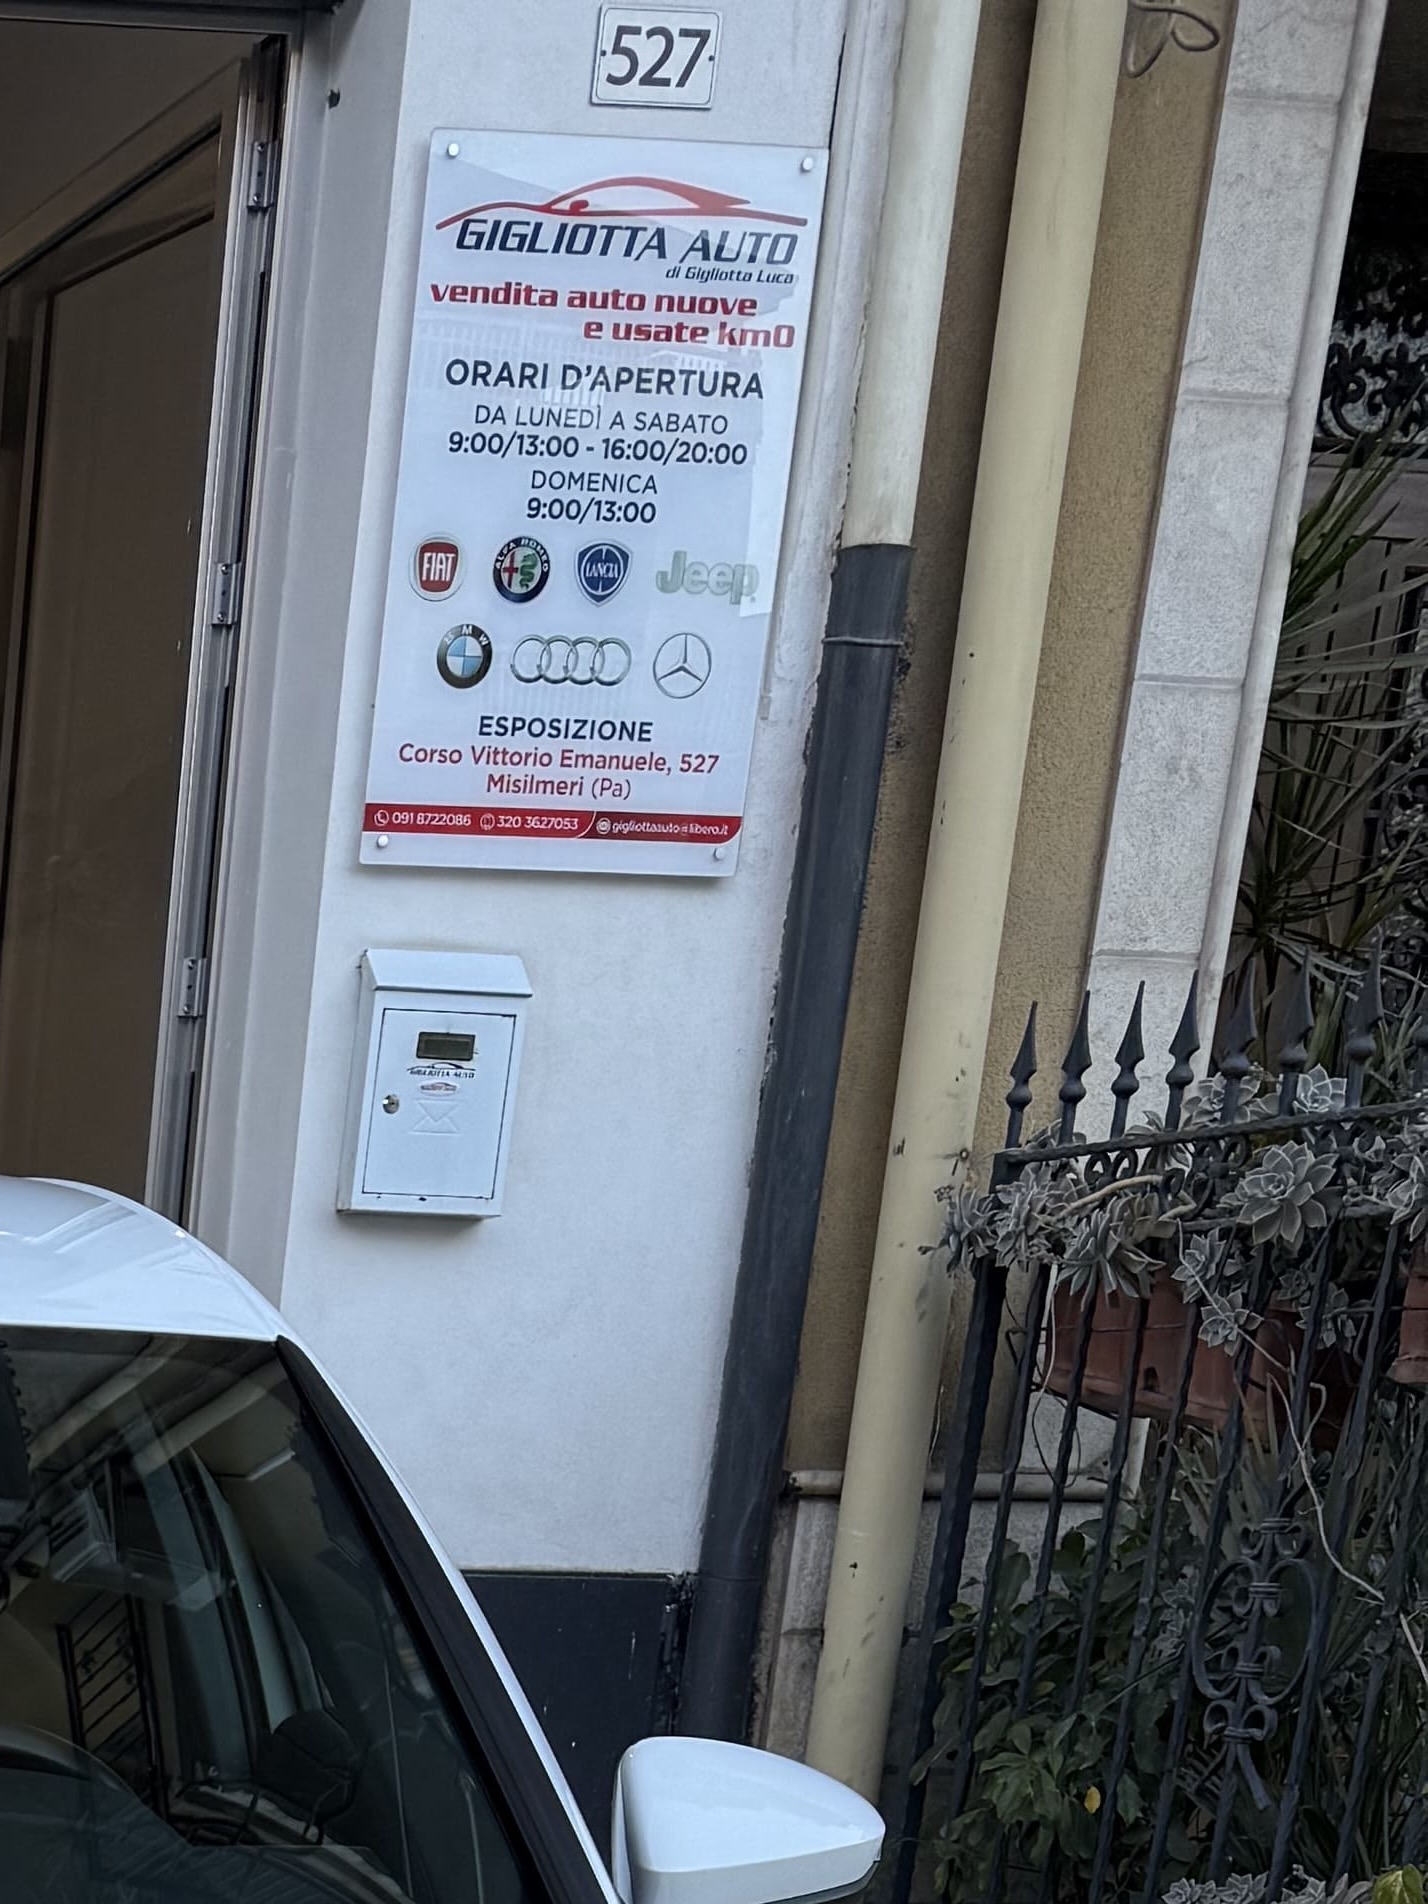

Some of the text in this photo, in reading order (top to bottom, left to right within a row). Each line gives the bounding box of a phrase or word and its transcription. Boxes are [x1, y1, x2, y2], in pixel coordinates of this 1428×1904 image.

[605, 25, 712, 89] 527
[456, 218, 798, 265] GIGLIOTTA AUTO
[665, 265, 794, 284] di Gigliotta Luca
[430, 281, 757, 317] vendita auto nuove
[584, 320, 795, 348] e usate km0
[445, 358, 764, 400] ORARI D'APERTURA
[475, 404, 728, 435] DA LUNEDÌ A SABATO
[448, 431, 579, 459] 9:00/13:00
[601, 437, 748, 466] 16:00/20:00
[531, 470, 658, 495] DOMENICA
[526, 497, 657, 525] 9:00/13:00
[422, 552, 456, 582] FIAT
[586, 561, 618, 579] LANCIA
[655, 550, 760, 605] Jeep
[478, 715, 653, 742] ESPOSIZIONE
[399, 743, 720, 776] Corso Vittorio Emanuele, 527
[486, 773, 632, 800] Misilmeri (Pa)
[392, 811, 472, 827] 091 8722086
[497, 815, 579, 831] 320 3627053
